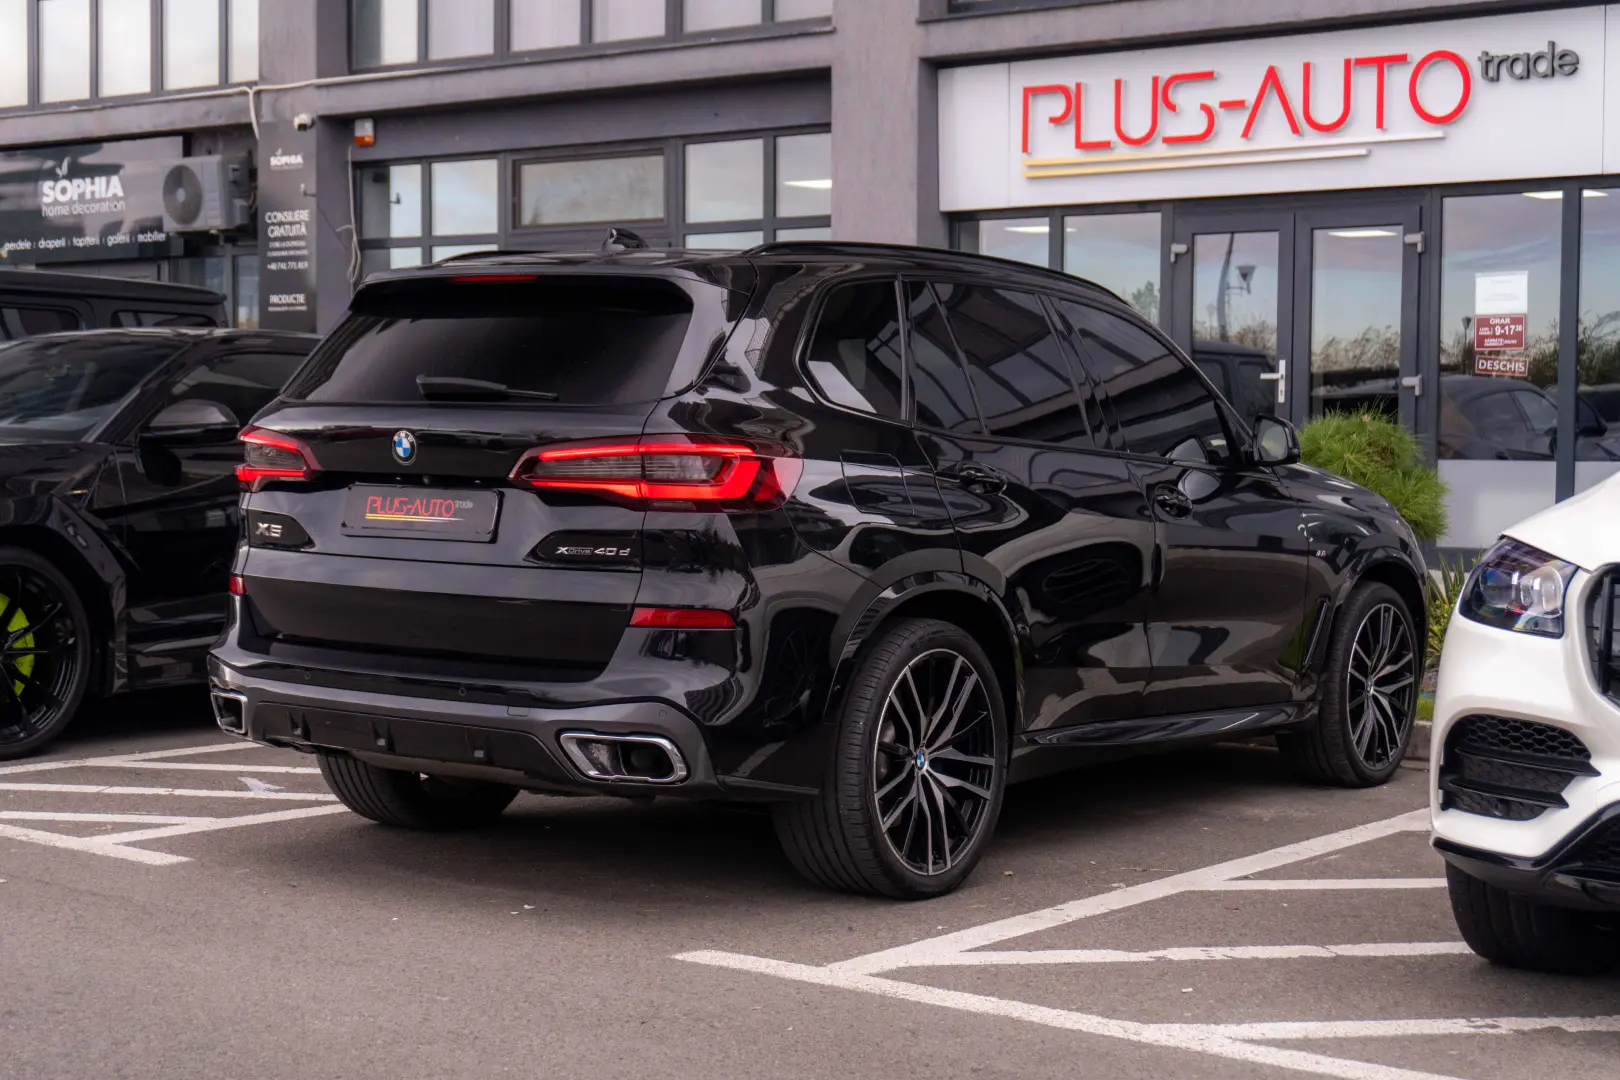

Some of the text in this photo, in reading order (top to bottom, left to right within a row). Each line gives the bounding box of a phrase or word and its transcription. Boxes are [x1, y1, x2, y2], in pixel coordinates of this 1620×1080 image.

[1022, 41, 1579, 154] PLUS-AUTO trade
[269, 154, 304, 166] SOPHIA
[42, 175, 124, 203] SOPHIA
[42, 200, 126, 217] home decoration
[1478, 360, 1525, 372] DESCHIS
[366, 496, 455, 517] PLUS-AUTO
[255, 522, 282, 538] X5
